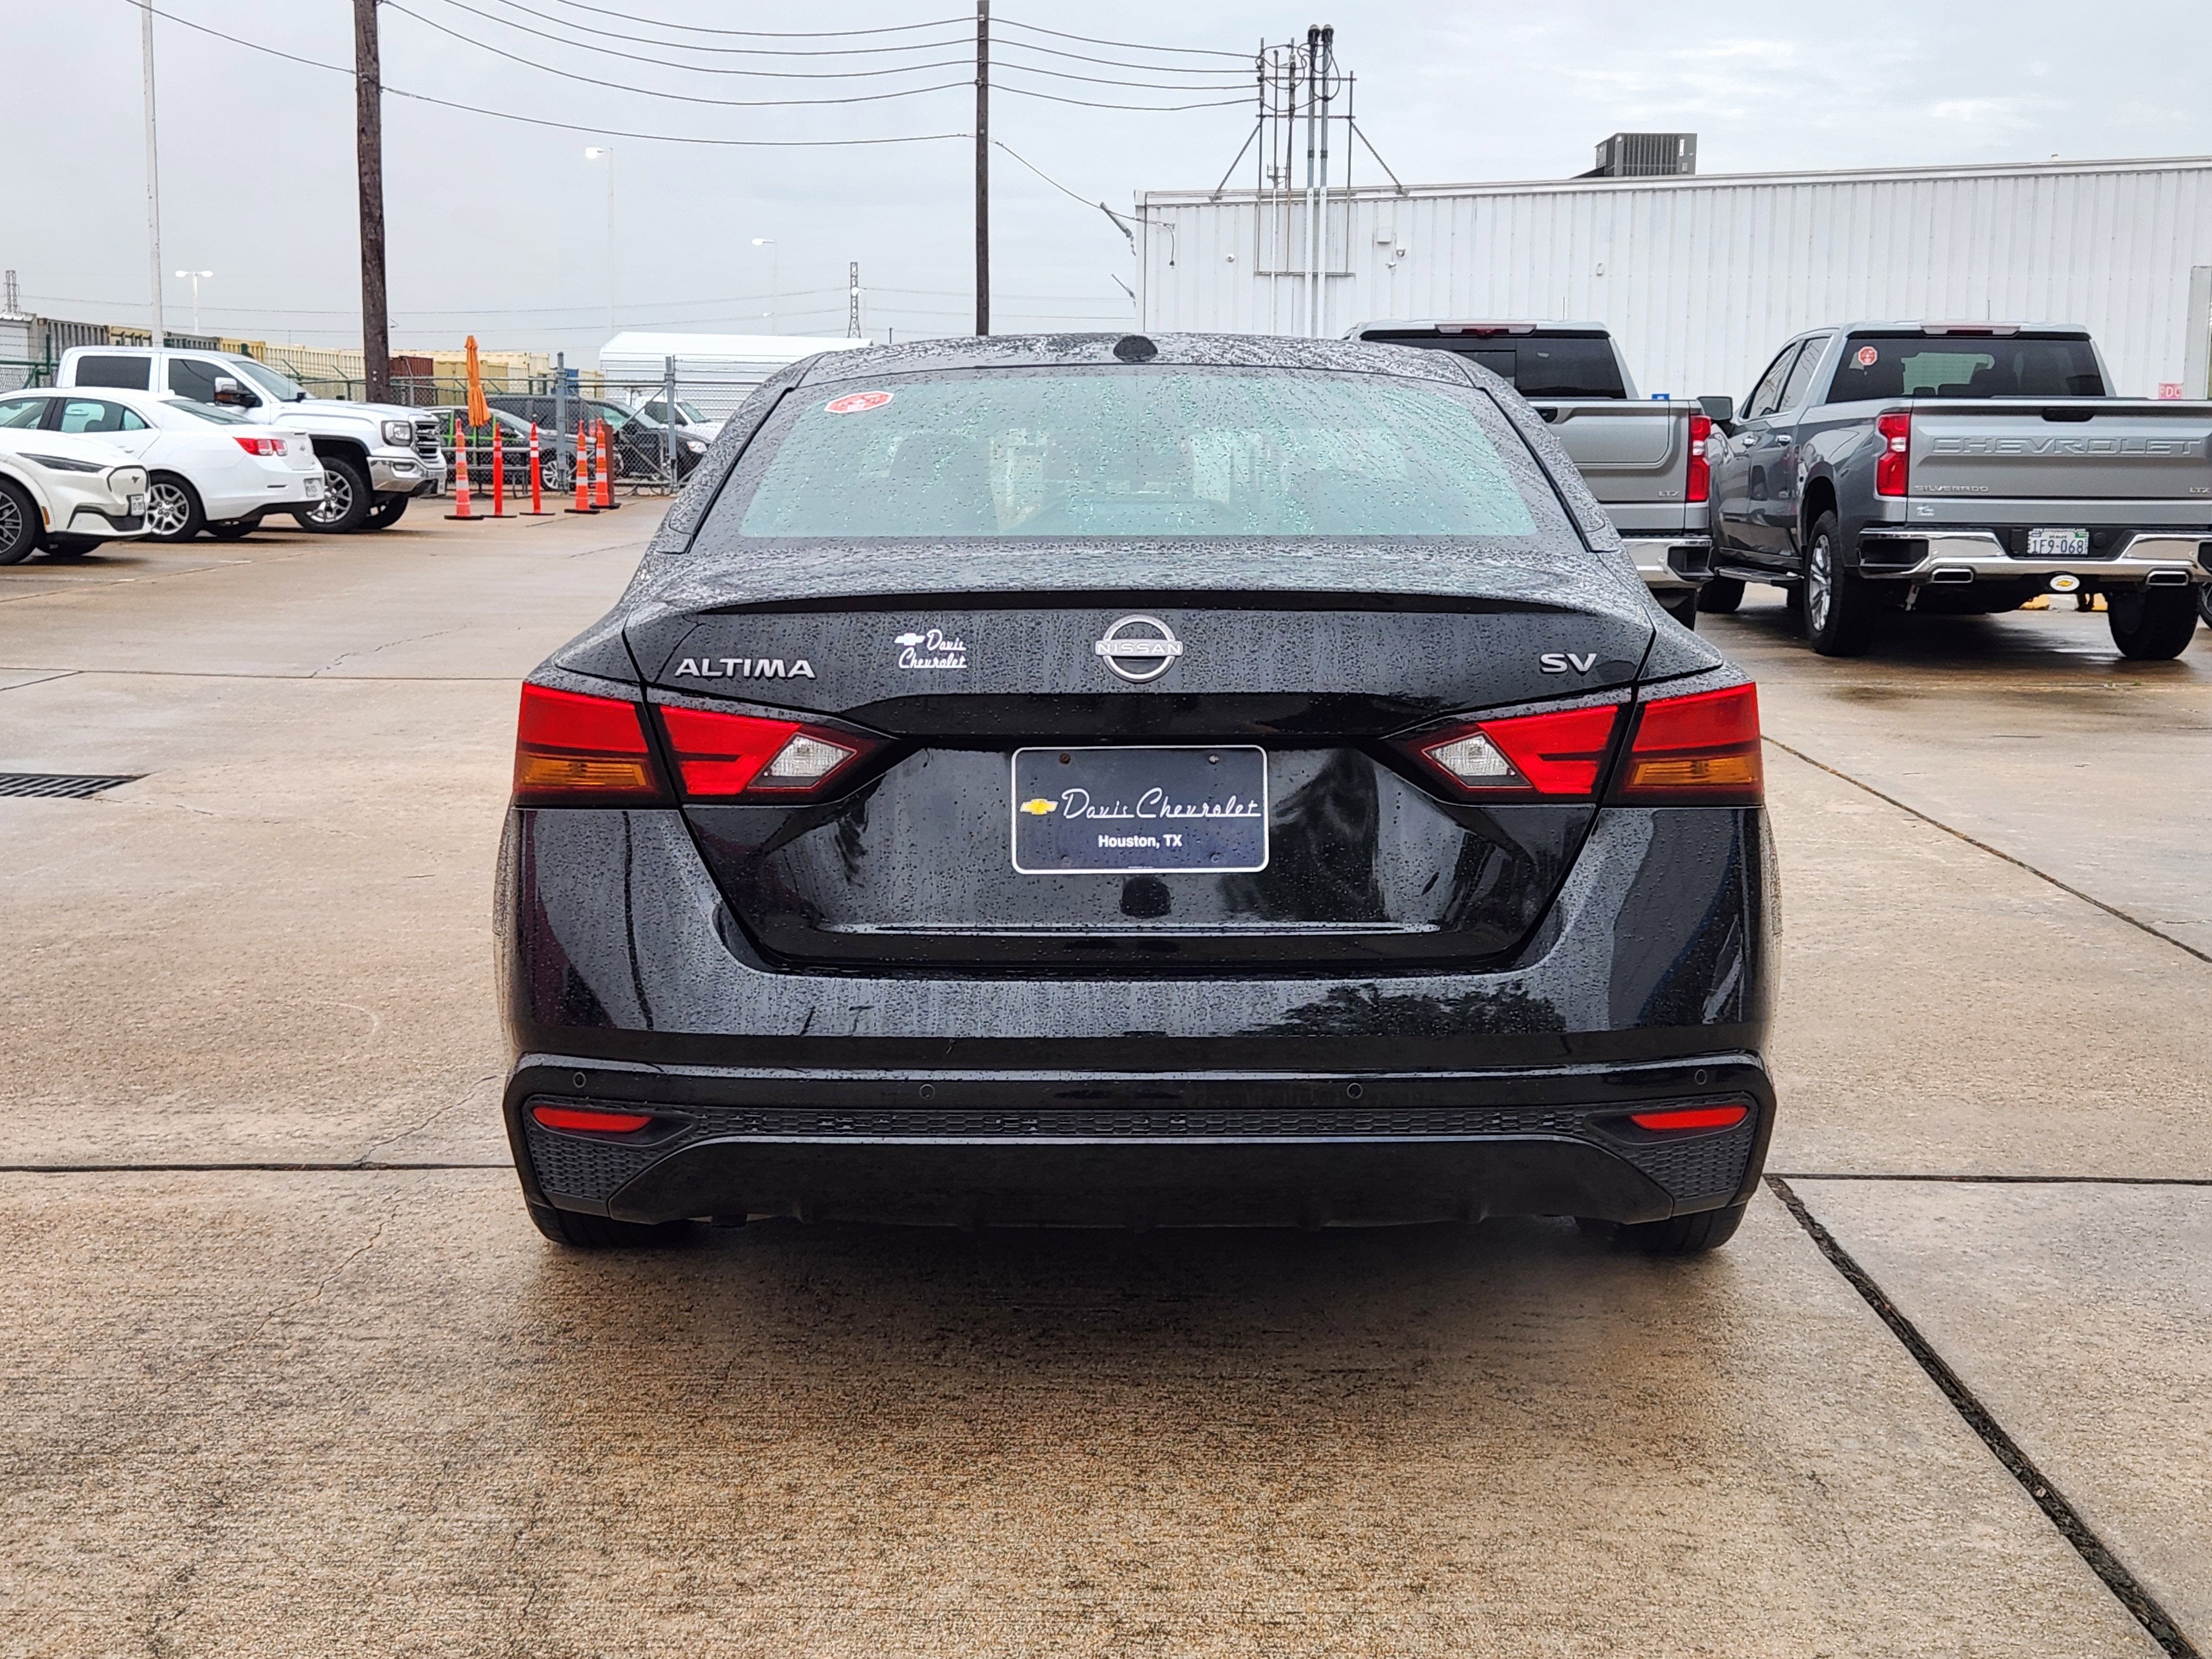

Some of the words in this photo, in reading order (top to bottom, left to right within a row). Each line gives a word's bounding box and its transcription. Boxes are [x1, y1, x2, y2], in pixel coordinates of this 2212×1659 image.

[1932, 437, 2201, 455] CHEVROLET
[926, 629, 967, 651] Davis
[1098, 643, 1181, 654] NISSAN
[898, 646, 968, 669] Chevrolet
[1540, 653, 1598, 673] SV
[674, 658, 816, 679] ALTIMA
[1061, 788, 1135, 820] Davis
[1136, 787, 1261, 818] Chevrolet
[1098, 834, 1160, 849] Houston,
[1163, 834, 1183, 847] TX
